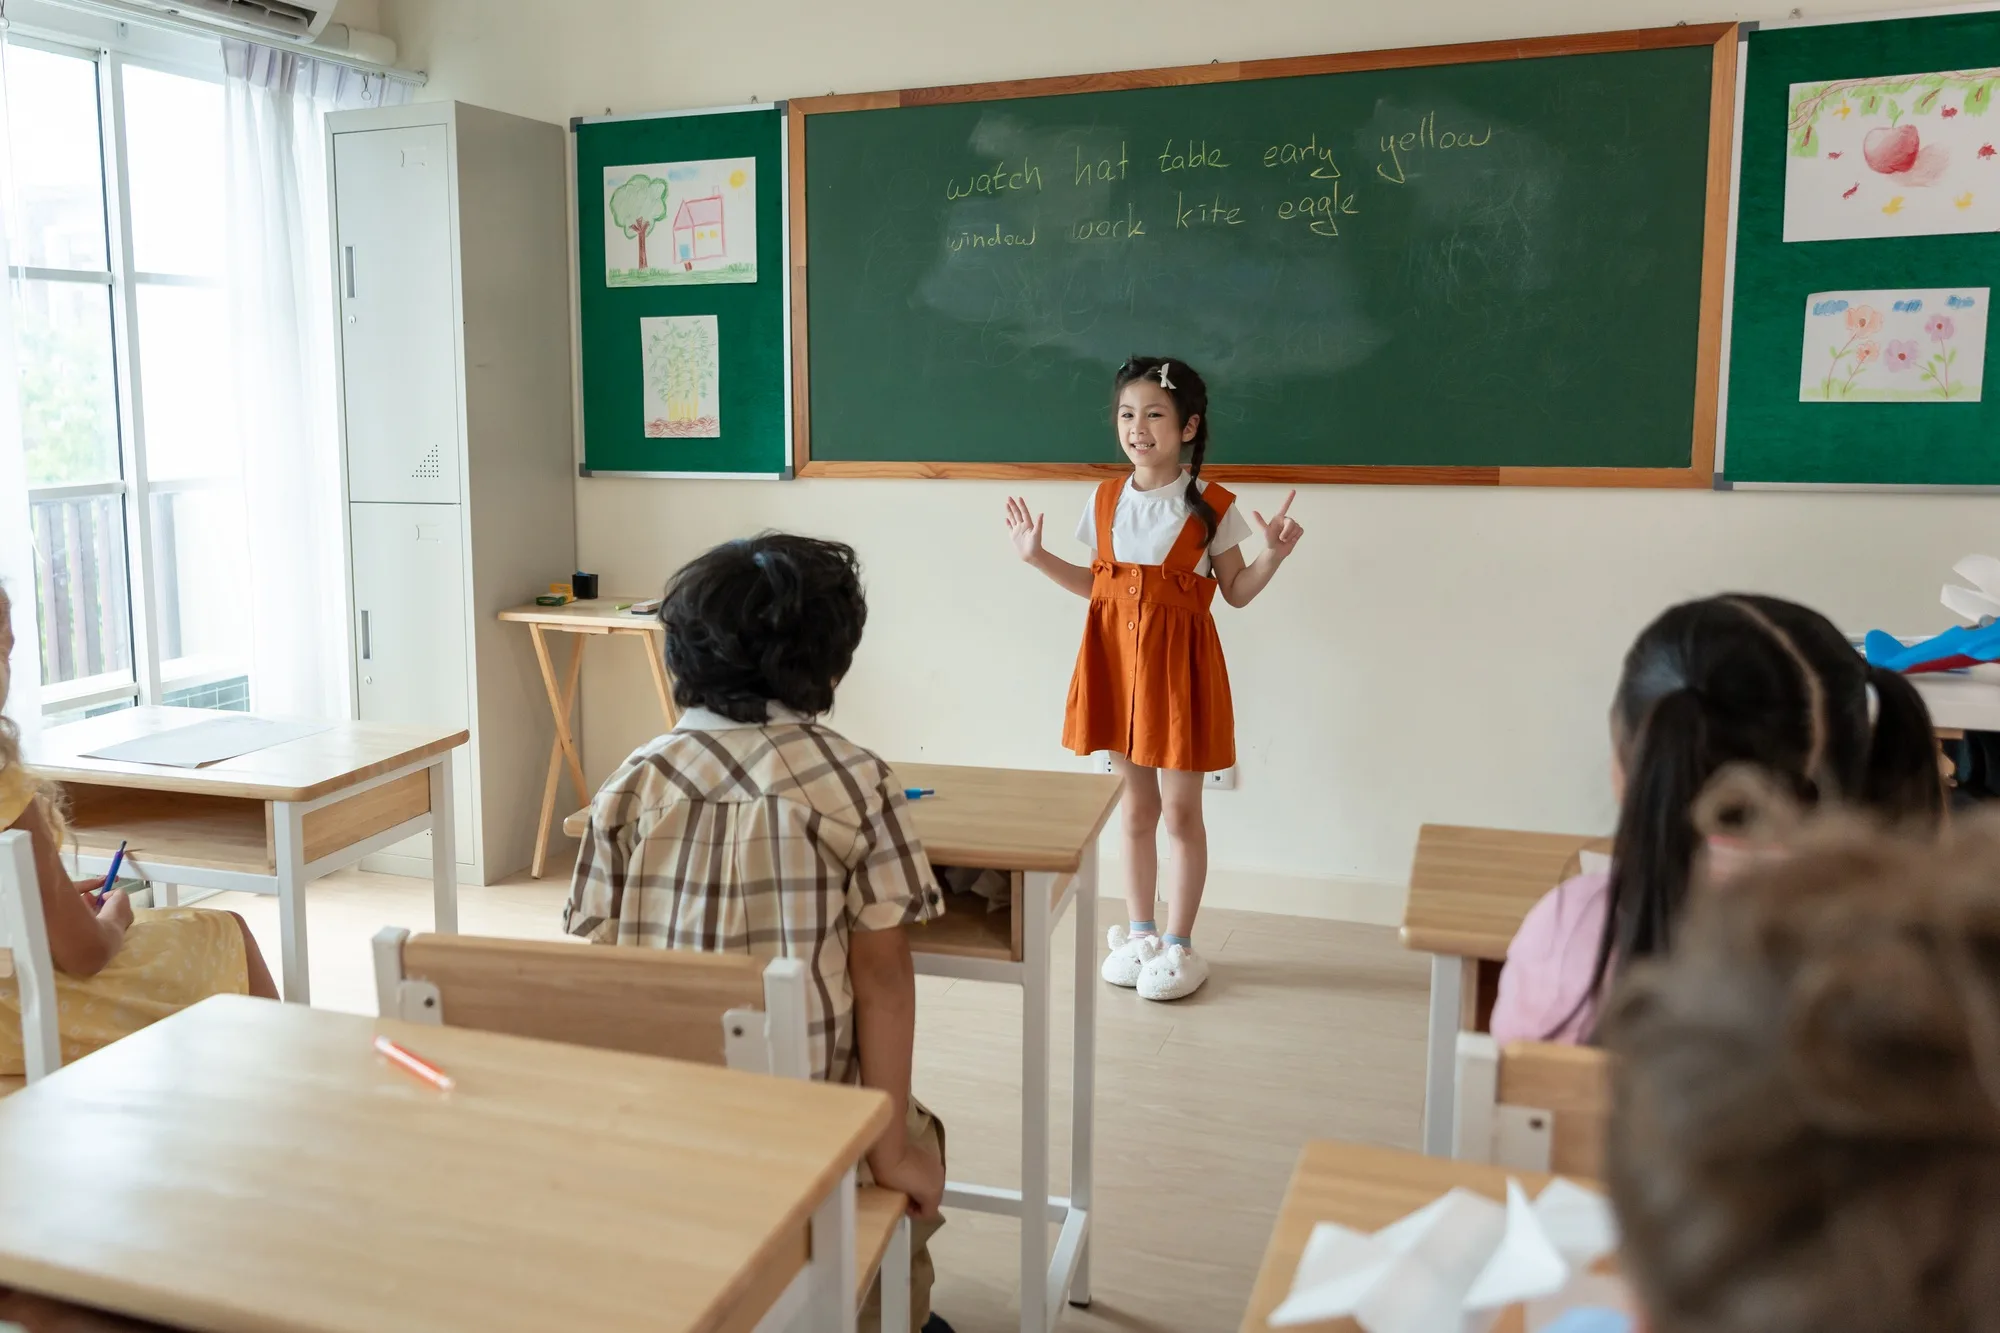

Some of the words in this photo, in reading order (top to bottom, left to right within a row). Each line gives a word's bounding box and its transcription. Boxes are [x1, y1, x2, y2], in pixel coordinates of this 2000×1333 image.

[946, 156, 1042, 200] watch
[1074, 140, 1129, 186] hat
[1158, 139, 1231, 173] table
[1263, 133, 1341, 179] early
[1376, 110, 1492, 184] yellow
[947, 223, 1036, 252] window
[1072, 202, 1146, 240] work
[1176, 191, 1246, 230] kite
[1278, 181, 1360, 237] eagle
